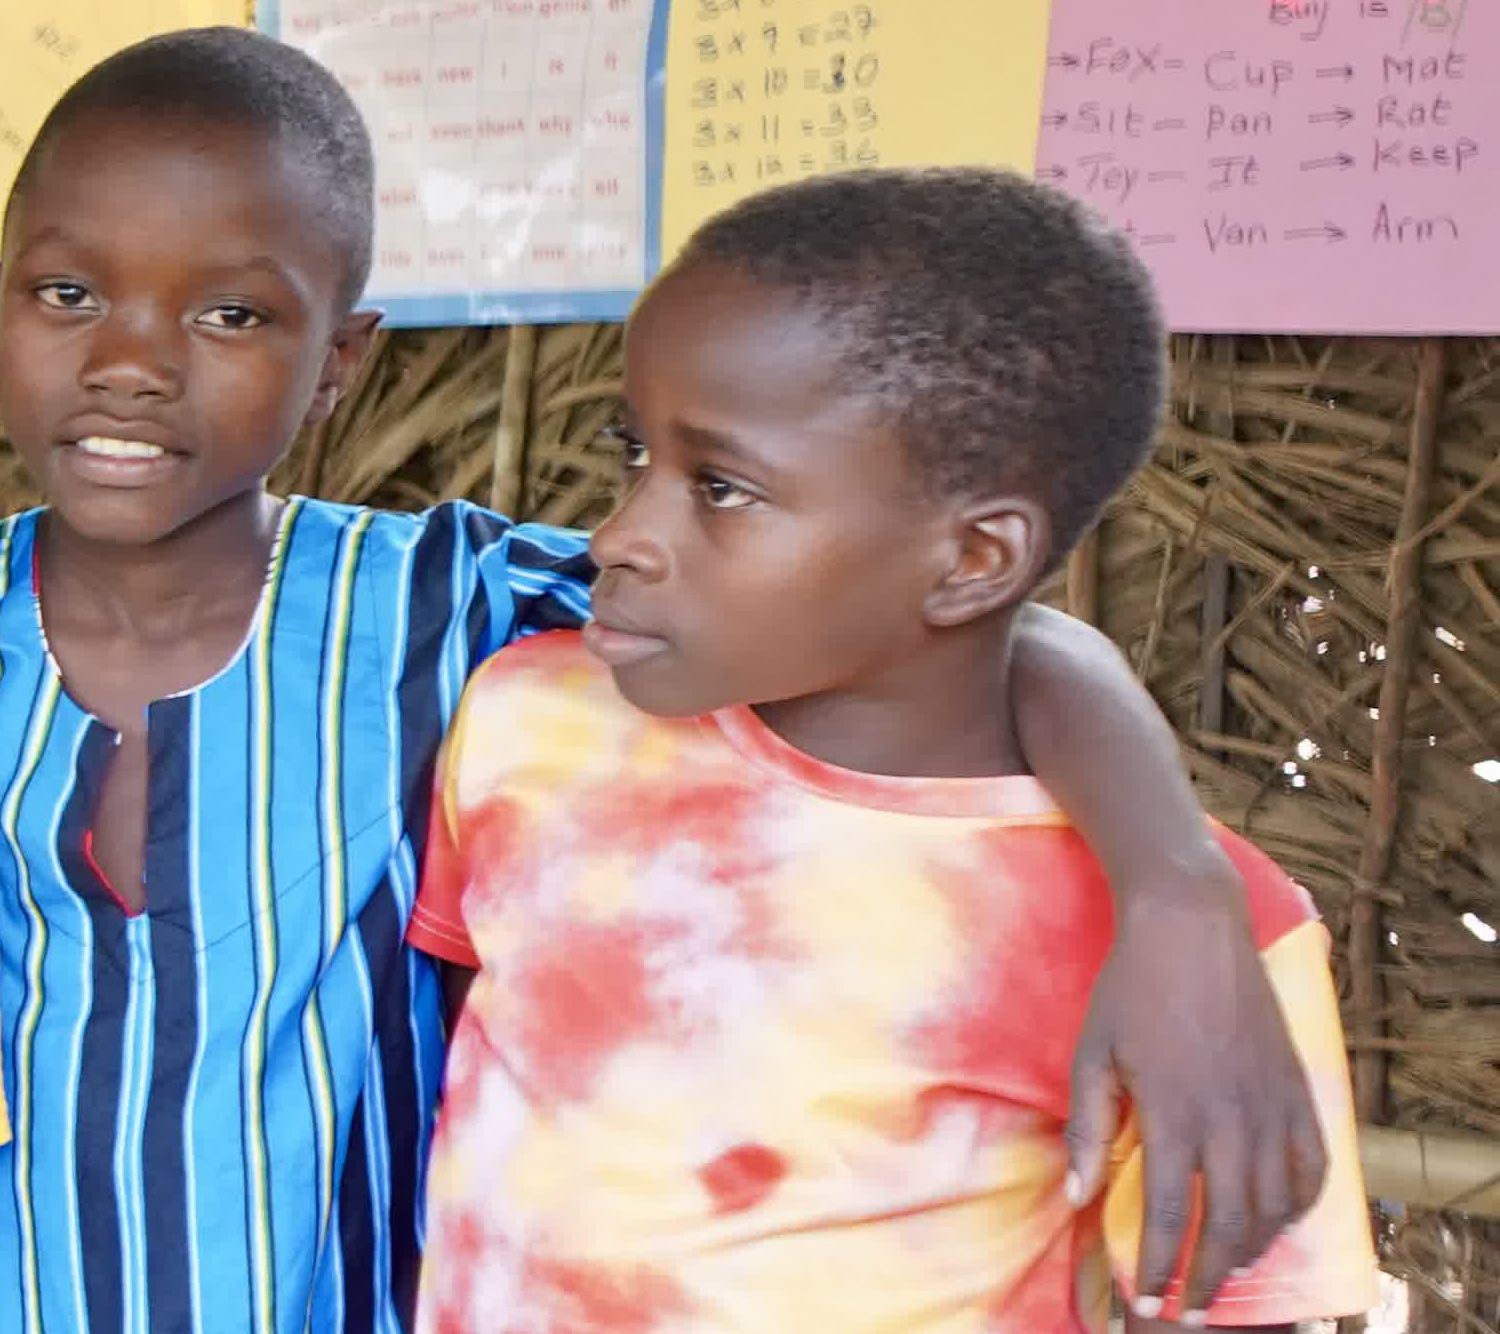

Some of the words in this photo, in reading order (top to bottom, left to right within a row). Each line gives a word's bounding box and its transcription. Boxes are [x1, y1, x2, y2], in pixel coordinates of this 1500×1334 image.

[1204, 50, 1296, 97] Cup
[1382, 50, 1468, 85] Mat
[1376, 92, 1454, 129] Rat
[1207, 154, 1261, 190] It
[1371, 136, 1480, 175] Keep
[1202, 211, 1269, 255] Van
[1371, 201, 1459, 244] Arm
